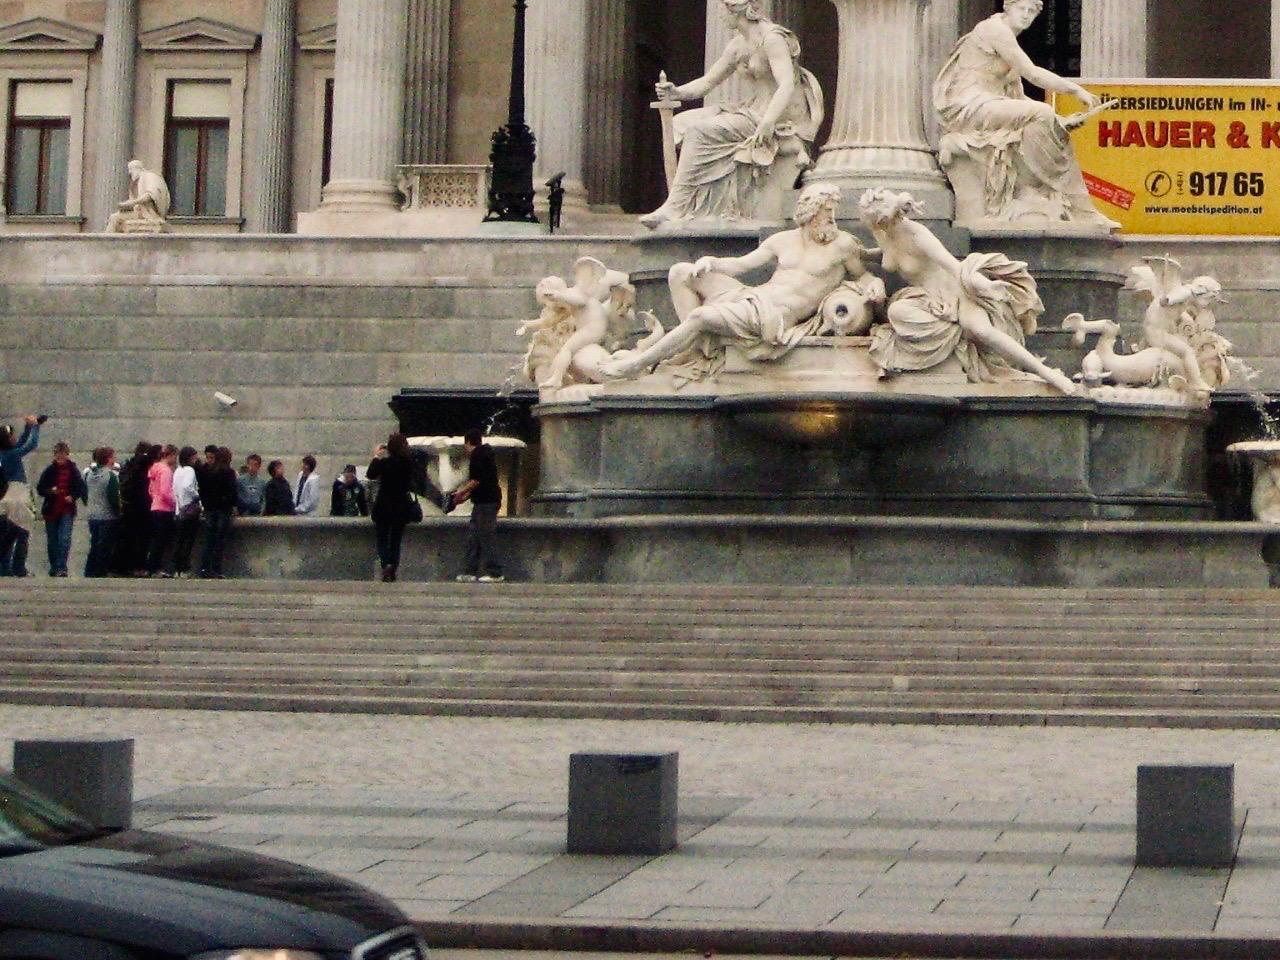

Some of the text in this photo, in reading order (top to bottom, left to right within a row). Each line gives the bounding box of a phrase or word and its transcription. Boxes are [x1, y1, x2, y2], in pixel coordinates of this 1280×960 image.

[1100, 93, 1224, 111] ÜBERSIEDLUNGEN
[1229, 97, 1246, 111] im
[1251, 97, 1272, 111] IN-
[1098, 120, 1216, 148] HAUER
[1226, 120, 1251, 149] &
[1189, 171, 1265, 197] 917 65
[1144, 204, 1263, 215] www.moebelspedition.at
